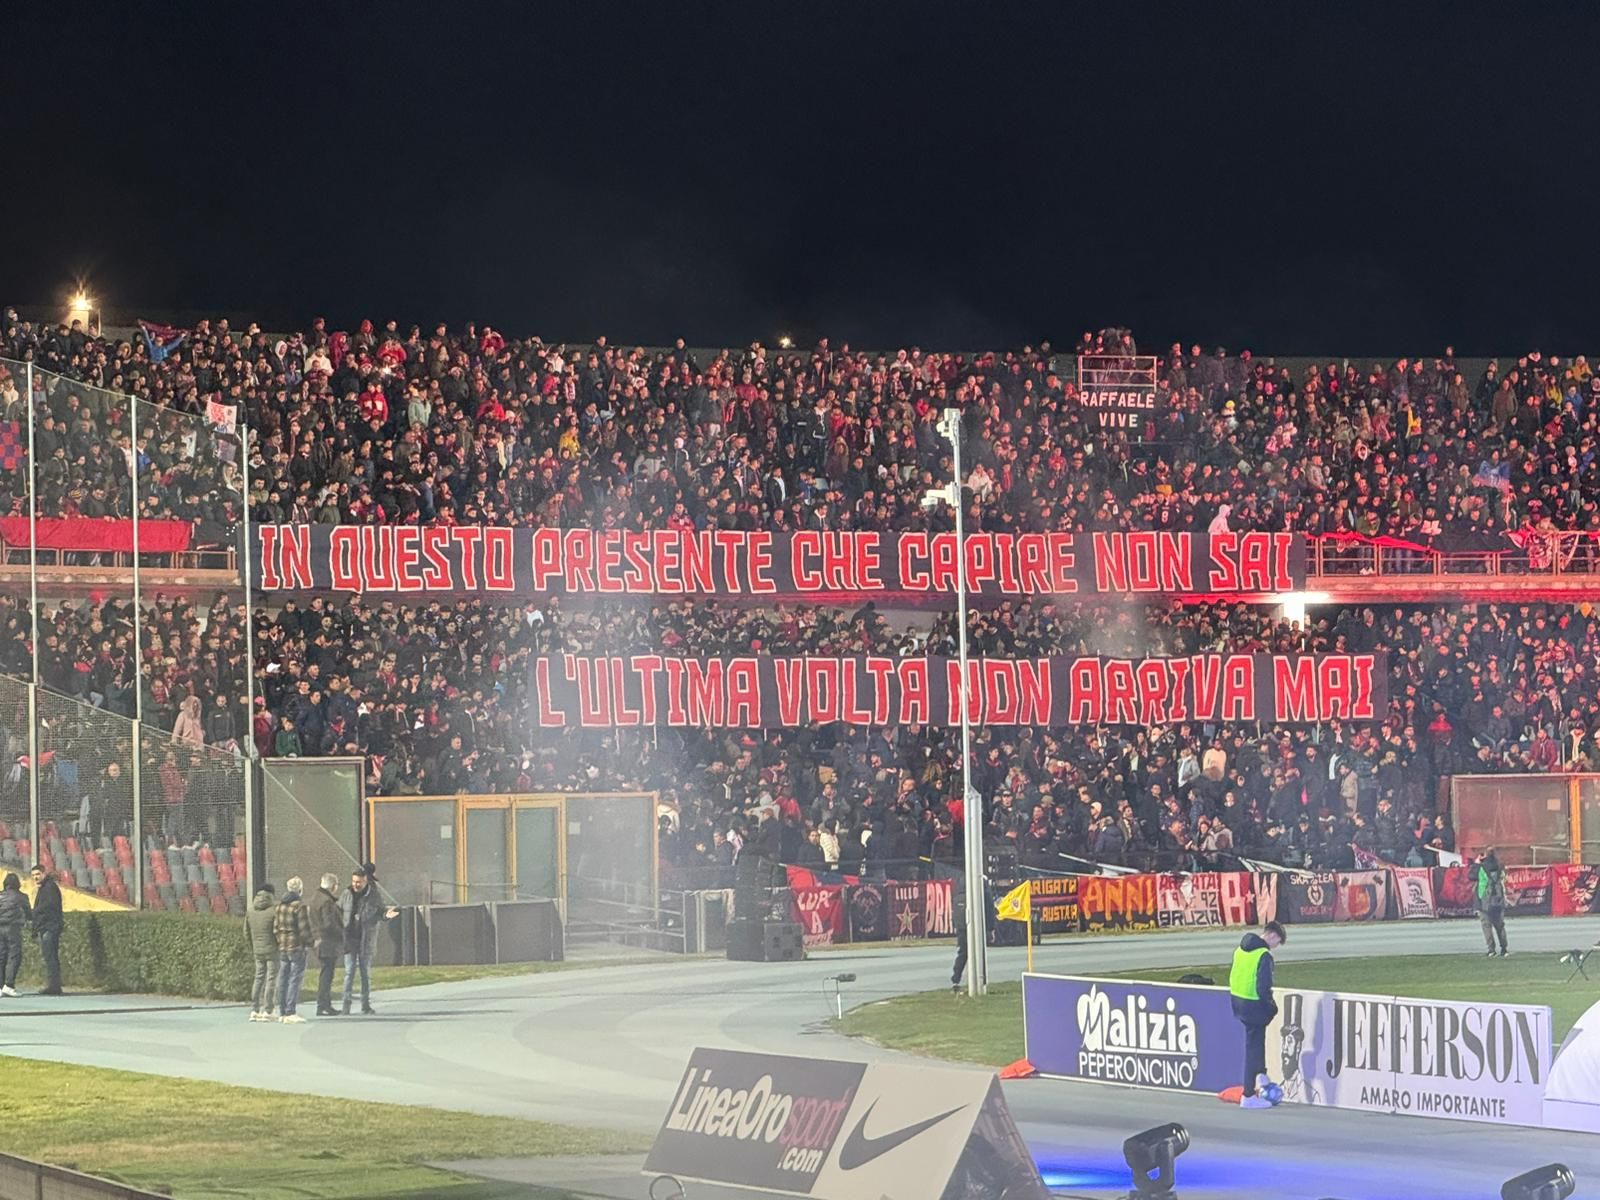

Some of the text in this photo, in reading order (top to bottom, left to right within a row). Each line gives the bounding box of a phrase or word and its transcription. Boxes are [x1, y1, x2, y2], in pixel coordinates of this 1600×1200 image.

[1080, 391, 1155, 408] RAFFAELE
[1099, 412, 1138, 427] VIVE
[258, 524, 1294, 594] IN QUESTO PRESENTE CHE CAPIRE NON SAI
[536, 654, 1375, 728] L'ULTIMA VOLTA NON ARRIVA MAI
[1030, 879, 1077, 895] RIGATA
[1159, 875, 1217, 891] ARATA
[1077, 984, 1197, 1053] Malizia
[1326, 998, 1541, 1085] JEFFERSON
[1360, 1089, 1506, 1118] AMARO IMPORTANTE
